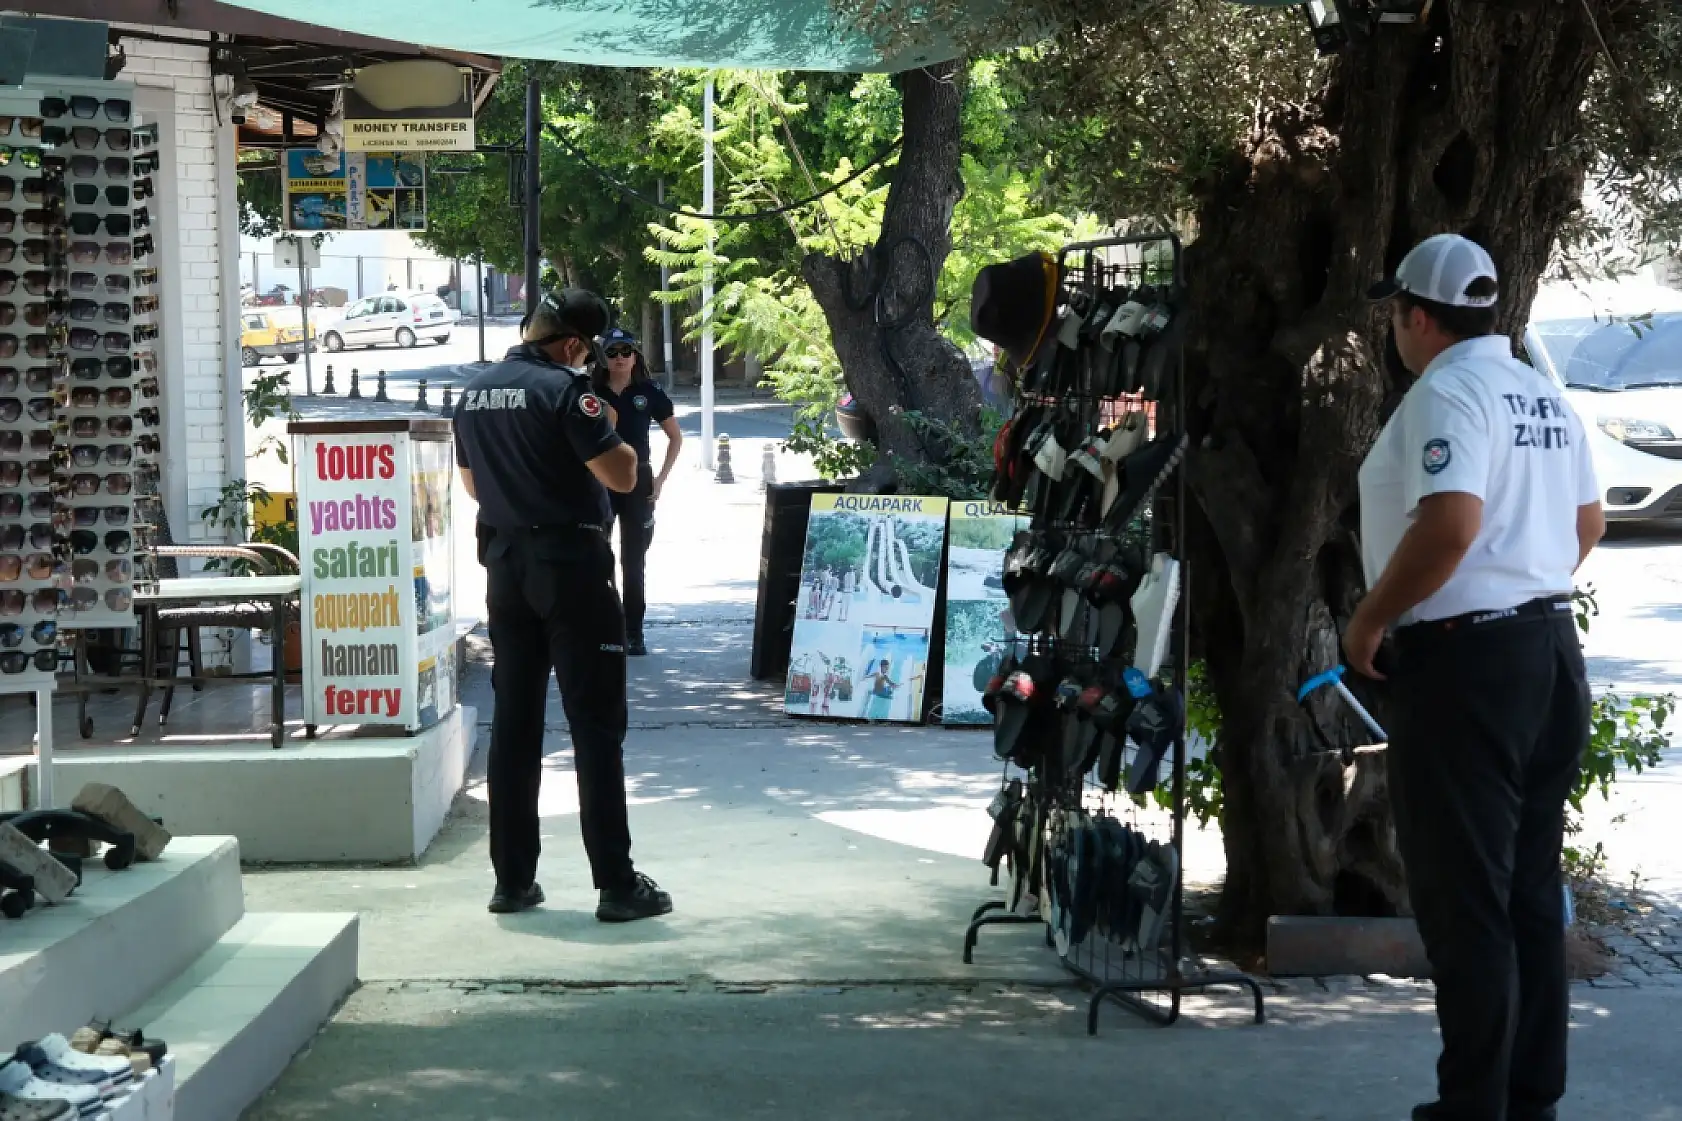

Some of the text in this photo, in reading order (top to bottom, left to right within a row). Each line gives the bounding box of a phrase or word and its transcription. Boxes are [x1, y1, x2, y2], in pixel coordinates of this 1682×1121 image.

[353, 122, 468, 133] MONEY TRANSFER
[362, 139, 395, 147] LICENSE
[315, 441, 395, 481] tours
[309, 493, 397, 536] yachts
[833, 496, 922, 513] AQUAPARK
[313, 539, 400, 579] safari
[314, 585, 401, 632] aquapark
[322, 638, 400, 677] hamam
[324, 684, 402, 717] ferry
